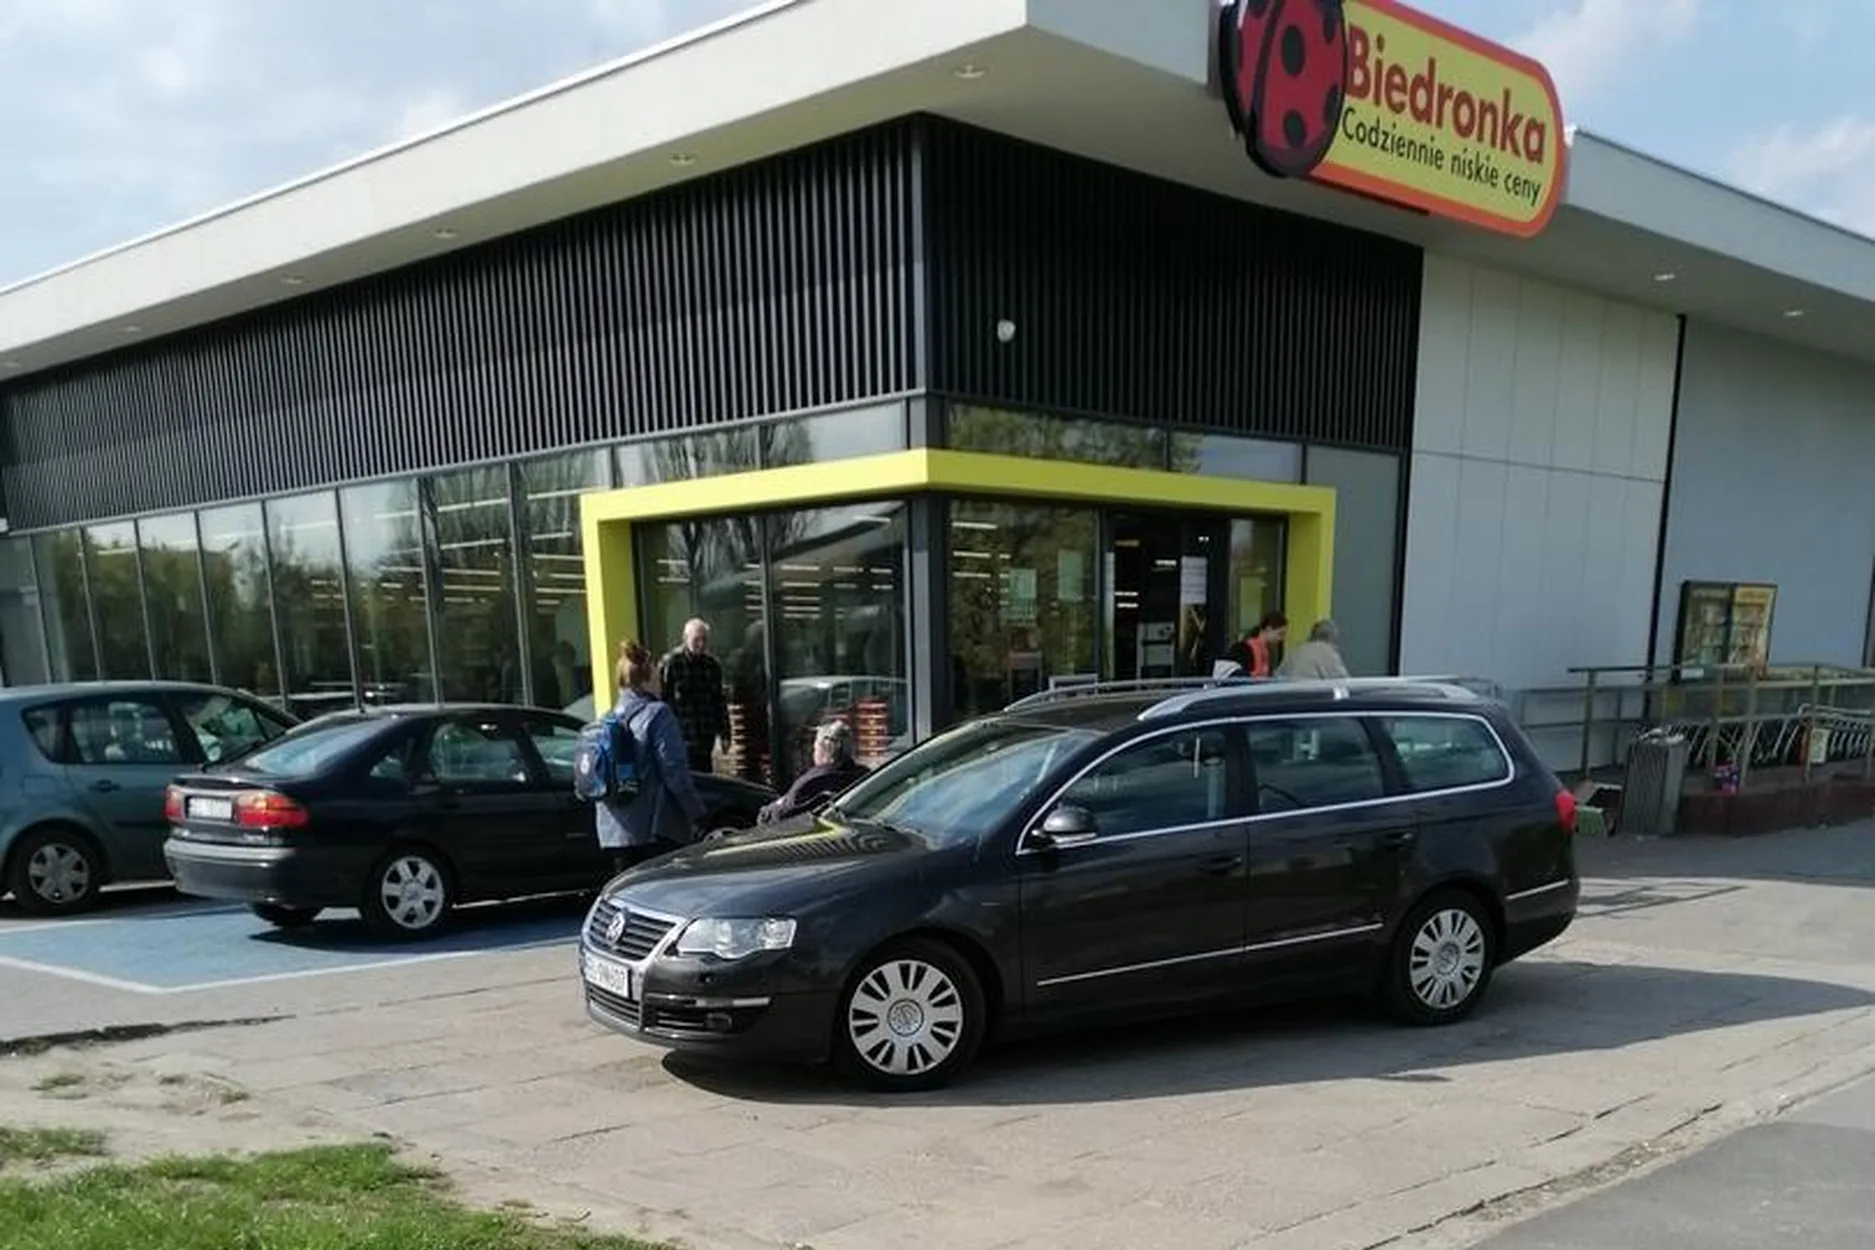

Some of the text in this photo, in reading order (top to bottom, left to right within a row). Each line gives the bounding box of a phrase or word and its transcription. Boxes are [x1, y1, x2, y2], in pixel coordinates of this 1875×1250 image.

[1345, 24, 1547, 164] Biedronka
[1342, 107, 1541, 206] Codziennie niskie ceny
